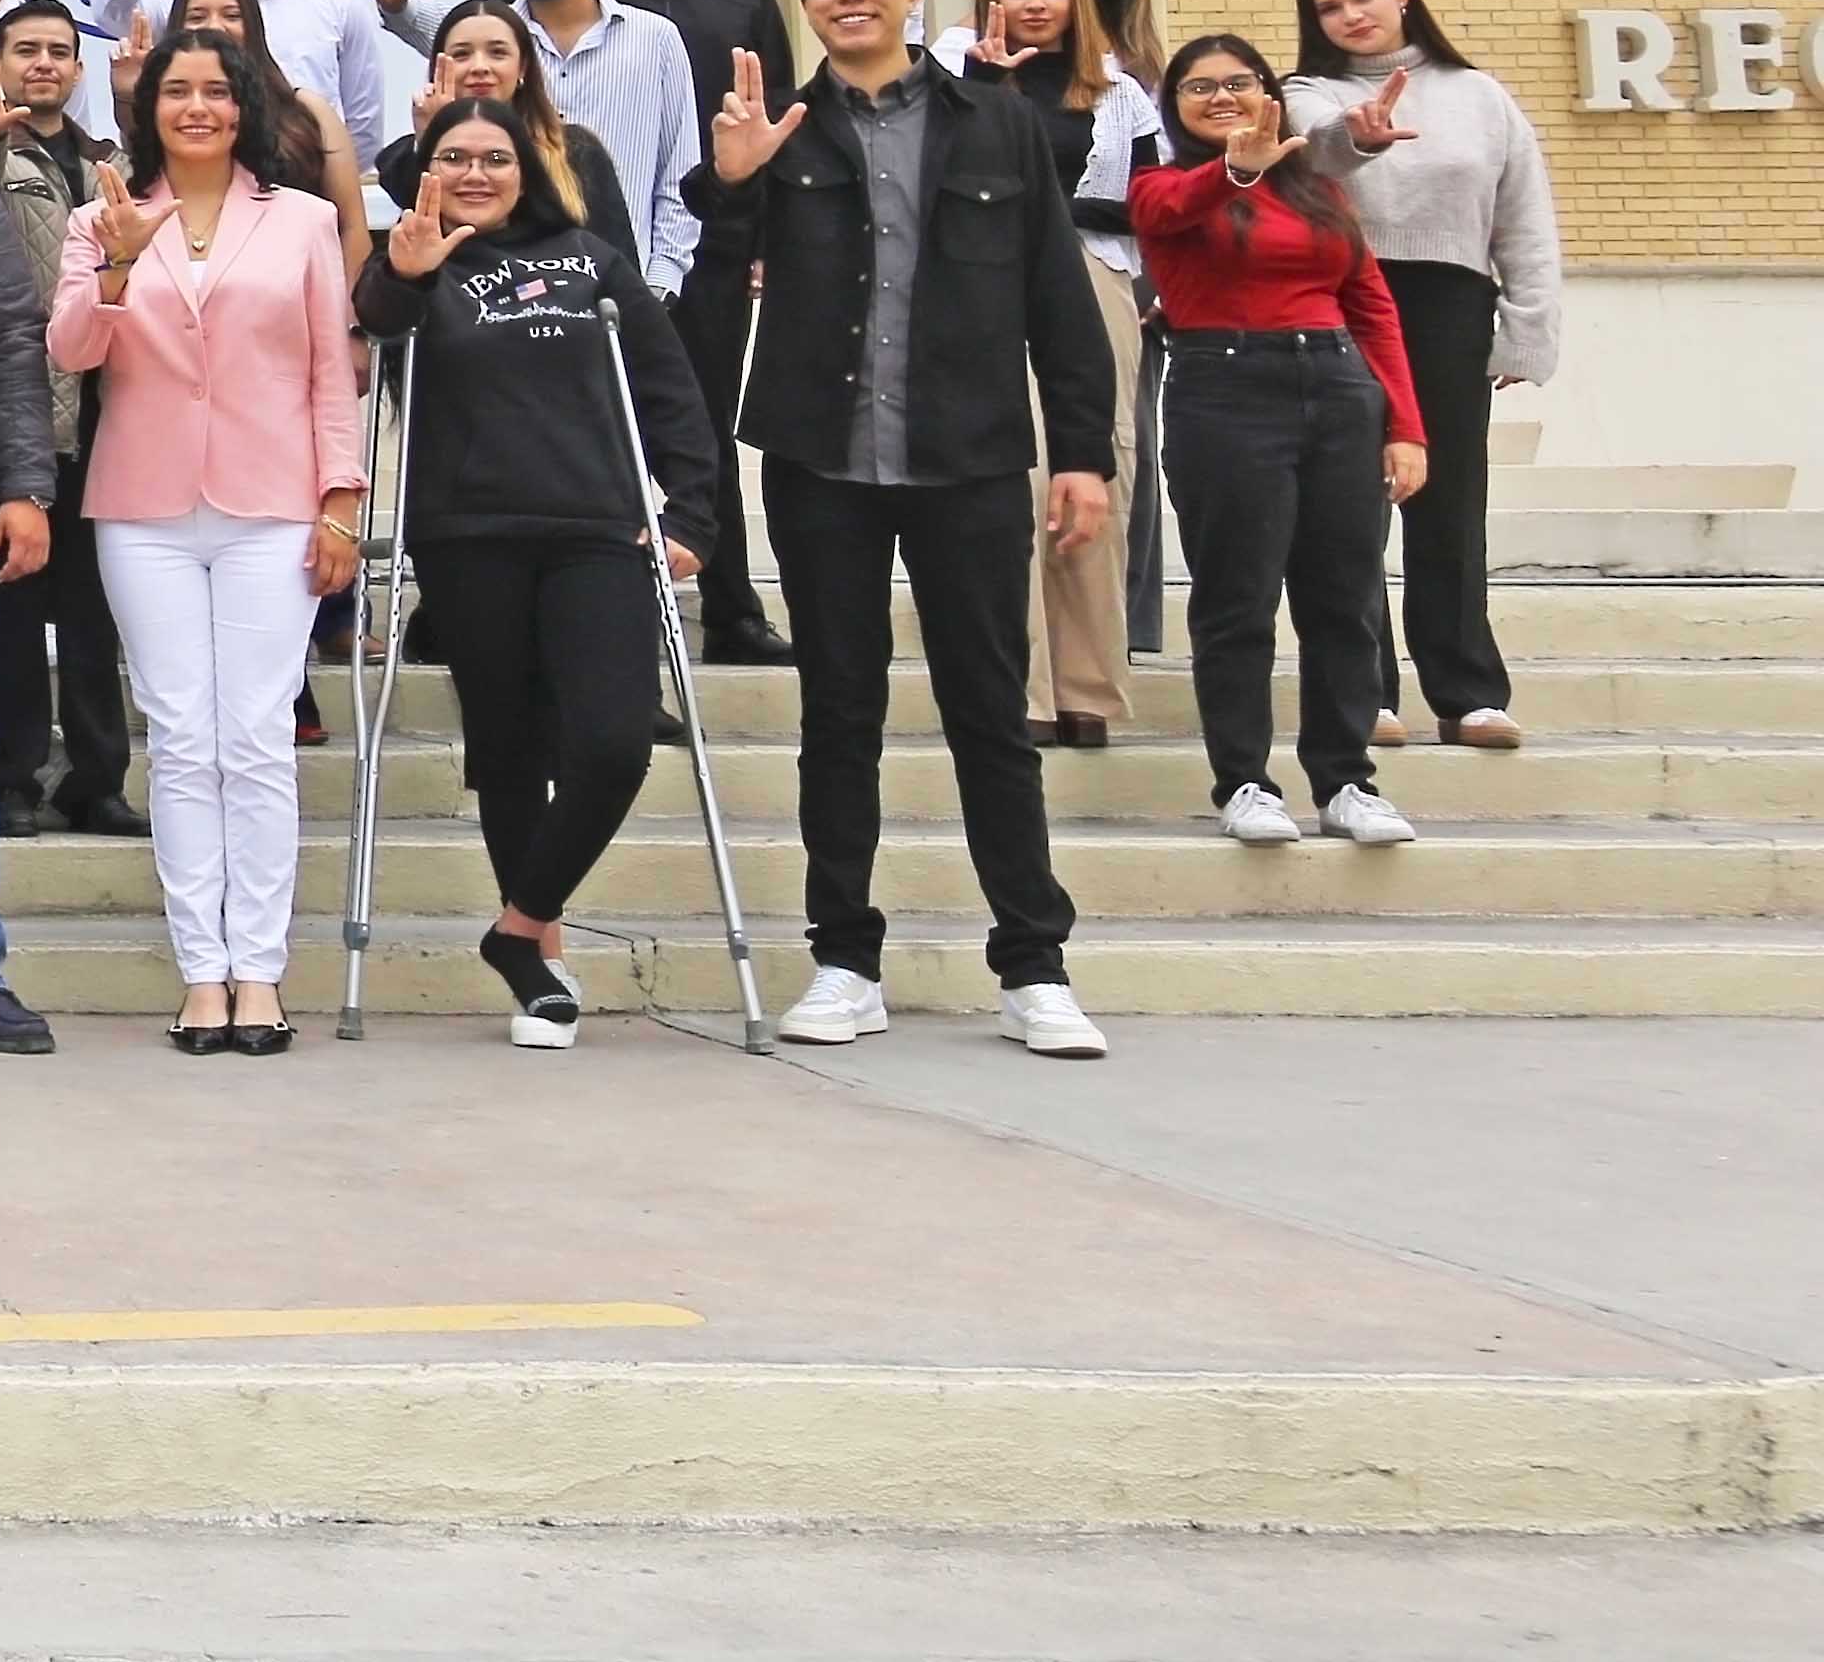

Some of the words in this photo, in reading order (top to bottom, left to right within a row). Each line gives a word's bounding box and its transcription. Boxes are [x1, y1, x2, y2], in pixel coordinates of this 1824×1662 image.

[1571, 8, 1824, 112] RE
[515, 255, 599, 280] YORK
[528, 324, 565, 338] USA
